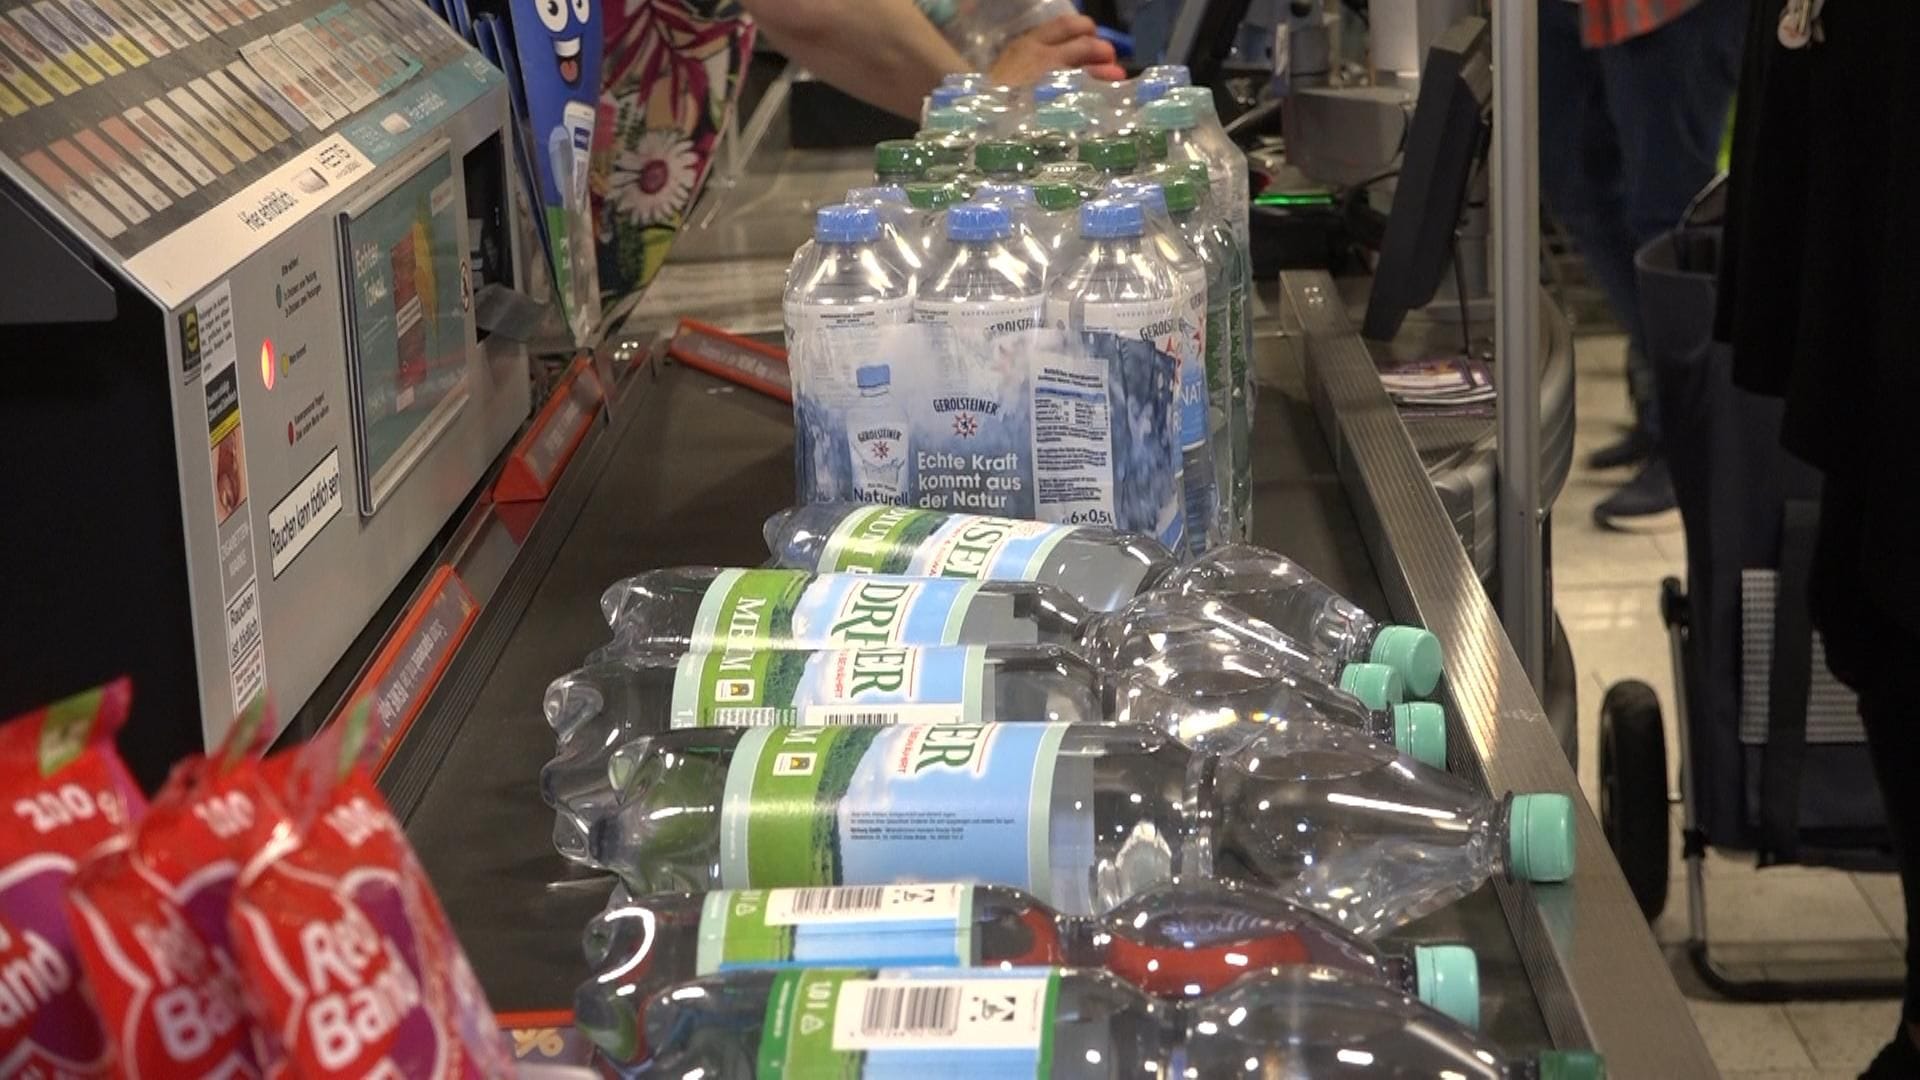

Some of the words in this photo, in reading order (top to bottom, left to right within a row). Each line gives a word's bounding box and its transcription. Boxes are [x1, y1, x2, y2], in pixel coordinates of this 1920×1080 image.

[932, 397, 1001, 416] GEROLSTEINER
[856, 428, 902, 442] GEROLSTEINER
[917, 451, 966, 470] Echte
[972, 452, 1019, 472] Kraft
[918, 474, 982, 491] kommt
[985, 477, 1022, 491] aus
[853, 487, 909, 506] Naturell
[919, 491, 949, 509] der
[952, 490, 1008, 508] Natur
[306, 937, 419, 1071] Band
